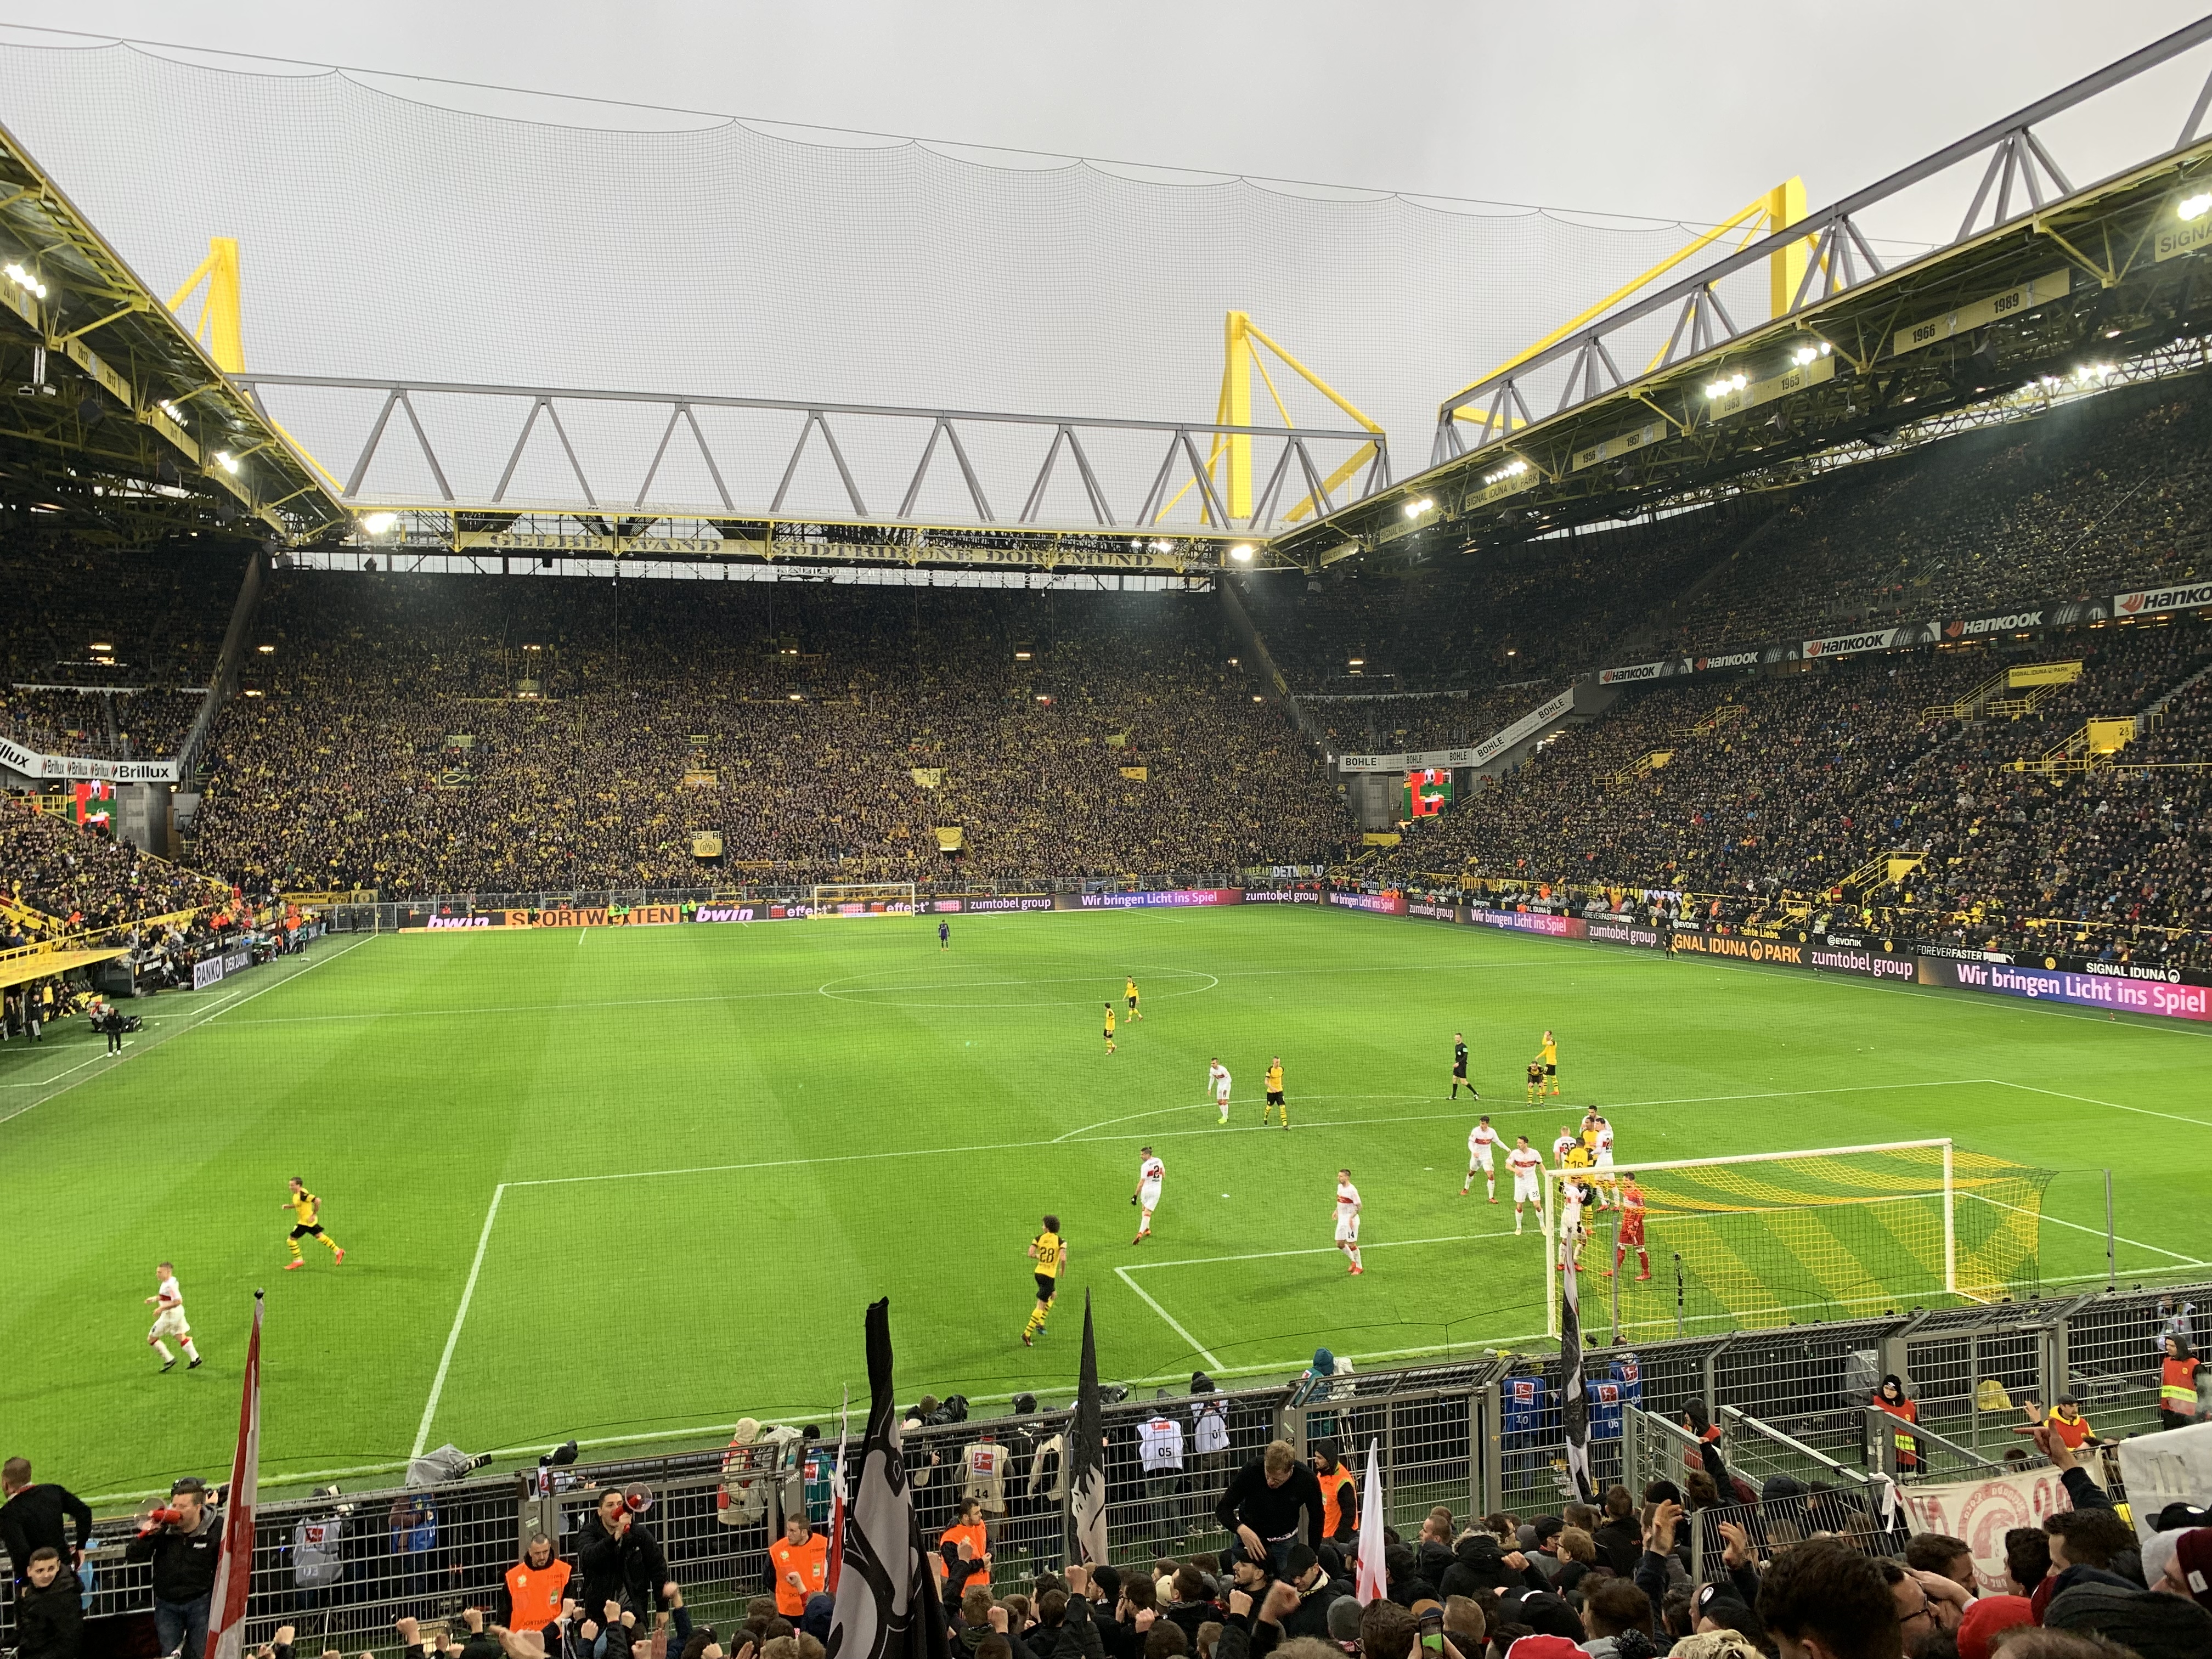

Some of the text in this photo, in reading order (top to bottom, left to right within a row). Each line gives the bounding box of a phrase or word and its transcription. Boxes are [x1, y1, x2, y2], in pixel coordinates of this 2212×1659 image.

[1994, 292, 2019, 314] 1989
[1912, 324, 1936, 343] 1966
[1781, 374, 1799, 391] 1965
[1724, 397, 1740, 411] 1963
[1627, 434, 1639, 447] 1957
[1583, 450, 1595, 464] 1956
[1466, 473, 1538, 507] SIGNAL IDUNA PARK
[490, 533, 602, 548] GELBE
[623, 537, 720, 551] WAND
[1538, 698, 1565, 719] BOHLE
[1477, 736, 1504, 757] BOHLE
[1346, 758, 1376, 766] BOHLE
[1407, 755, 1422, 764] BOHLE
[1450, 751, 1467, 760] BOHLE
[48, 759, 64, 774] Brillux
[72, 761, 88, 775] Brillux
[94, 763, 109, 777] Brillux
[120, 765, 169, 777] Brillux
[970, 898, 1051, 910] zumtobel group
[1082, 891, 1217, 907] Wir bringen Licht ins Spiel
[1246, 890, 1318, 903] zumtobel group
[1330, 893, 1395, 912] Wir bringen Licht ins Spiel
[696, 905, 753, 922] bwin
[1409, 904, 1454, 921] zumtobel group
[1471, 909, 1483, 922] Wir
[1485, 910, 1513, 928] bringen
[1514, 913, 1532, 928] Licht
[1534, 916, 1545, 930] ins
[1547, 917, 1566, 935] Spiel
[1679, 921, 1699, 930] EVONIK
[1589, 925, 1657, 948] zumtobel group
[1835, 936, 1862, 947] EVONIK
[1674, 933, 1801, 964] GNAL IDUNA PARK
[1917, 945, 1982, 961] FOREVERFASTER
[196, 960, 221, 988] RANKO
[225, 956, 235, 973] DER
[1812, 951, 1913, 980] zumtobel group
[2086, 962, 2166, 981] SIGNAL IDUNA
[1957, 963, 2206, 1015] Wir bringen Licht ins Spiel
[1153, 1165, 1159, 1178] 2
[1040, 1246, 1054, 1263] 28
[1516, 1414, 1529, 1425] 10
[1158, 1447, 1172, 1457] 05
[974, 1488, 989, 1499] 14
